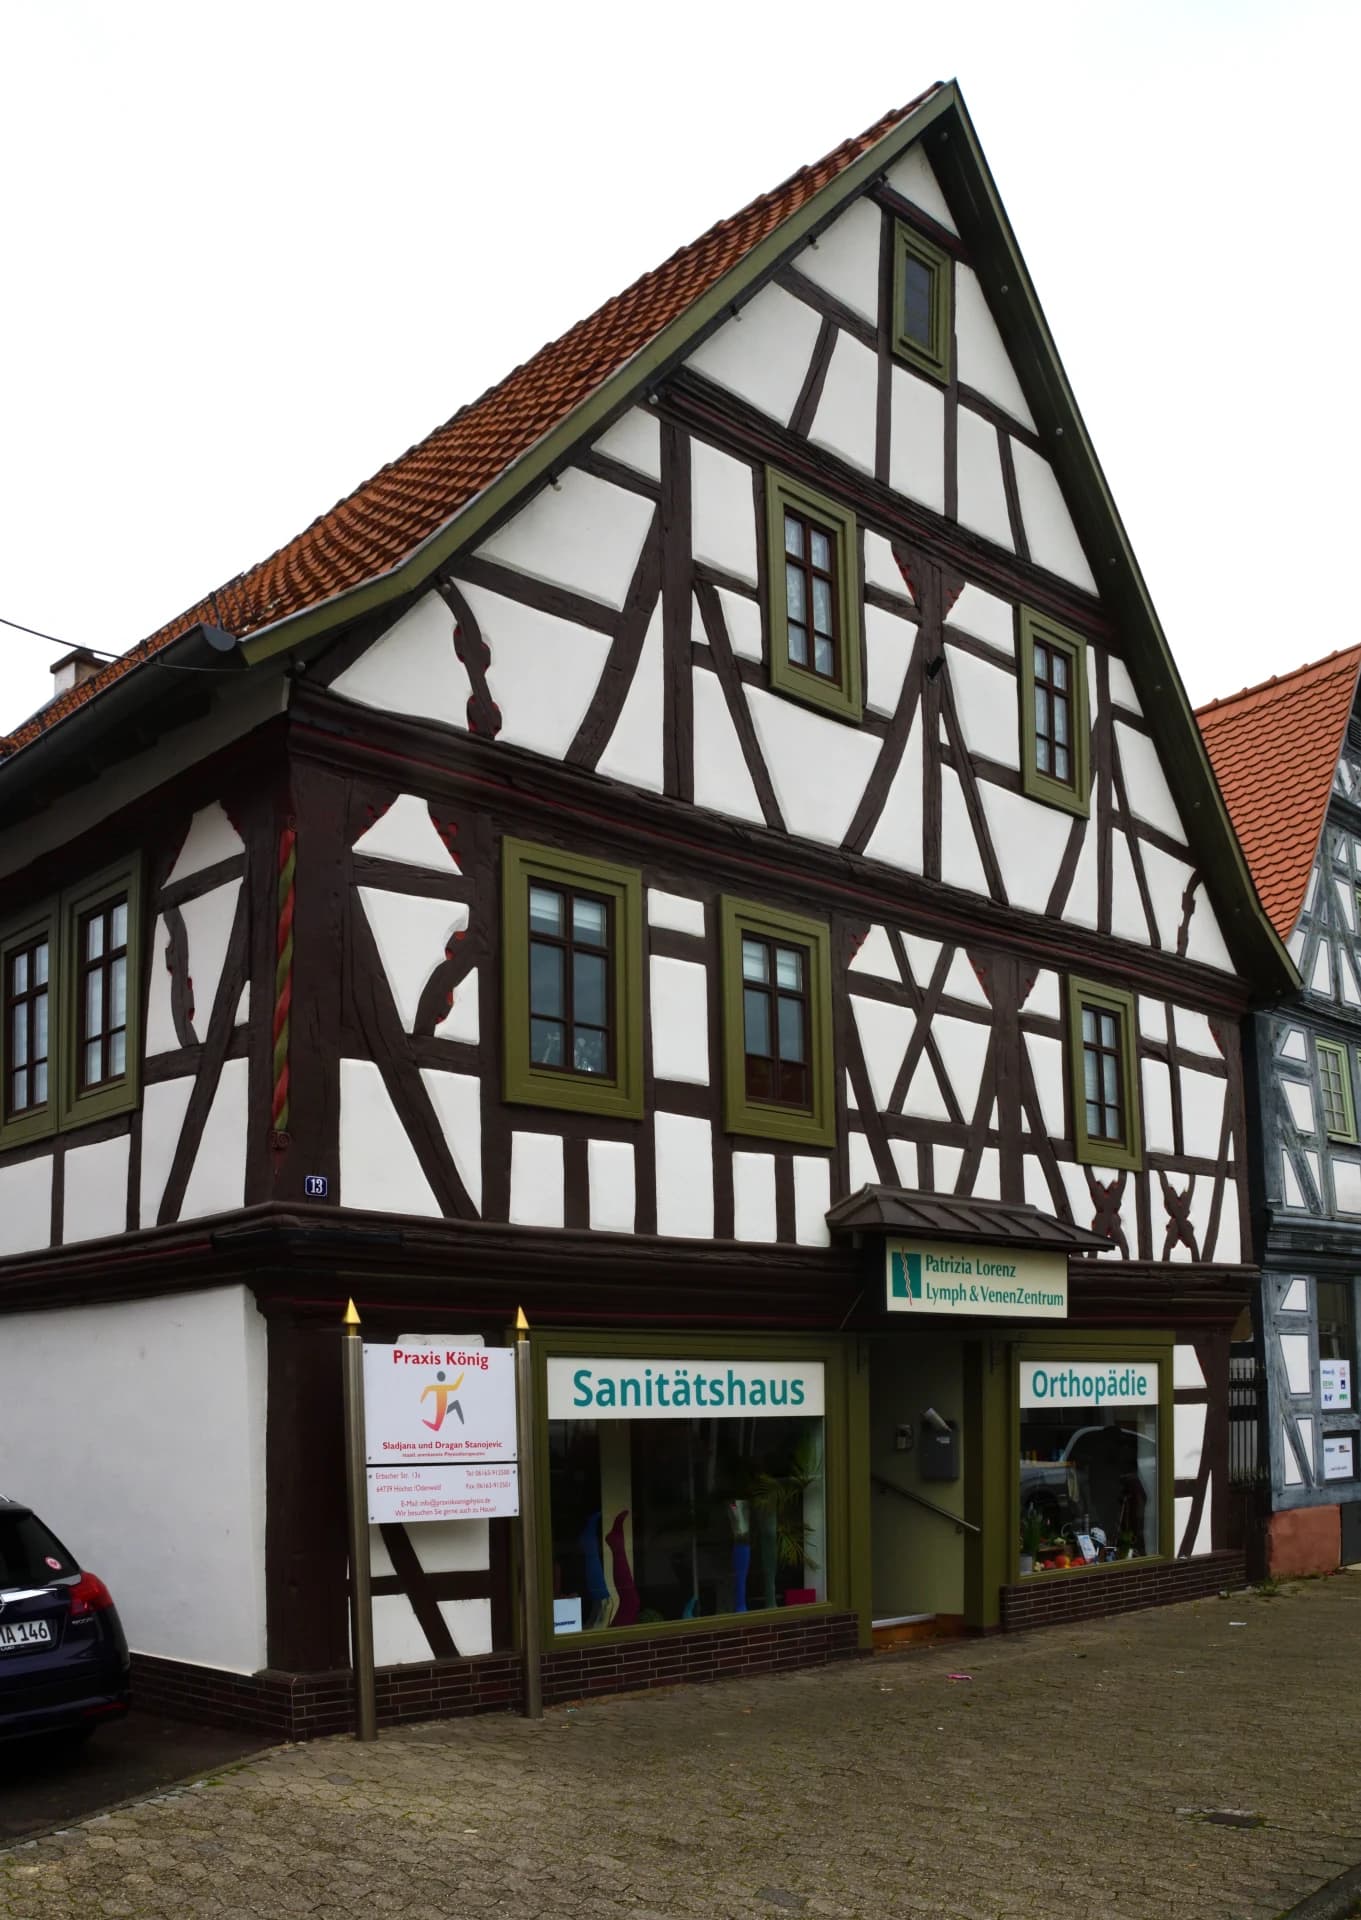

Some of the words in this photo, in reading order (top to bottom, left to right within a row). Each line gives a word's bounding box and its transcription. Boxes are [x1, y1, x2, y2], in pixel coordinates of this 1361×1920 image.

[310, 1178, 323, 1194] 13
[925, 1254, 972, 1274] Patrizia
[976, 1258, 1017, 1278] Lorenz
[926, 1282, 967, 1306] Lymph
[969, 1285, 979, 1302] &
[980, 1285, 1064, 1306] VenenZentrum
[393, 1349, 441, 1365] Praxis
[446, 1351, 489, 1370] König
[573, 1369, 805, 1408] Sanitätshaus
[1032, 1368, 1148, 1405] Orthopädie
[382, 1441, 416, 1451] Sladjana
[418, 1441, 433, 1449] und
[435, 1441, 463, 1450] Dragan
[464, 1440, 503, 1449] Stanojevic
[18, 1622, 48, 1642] 146
